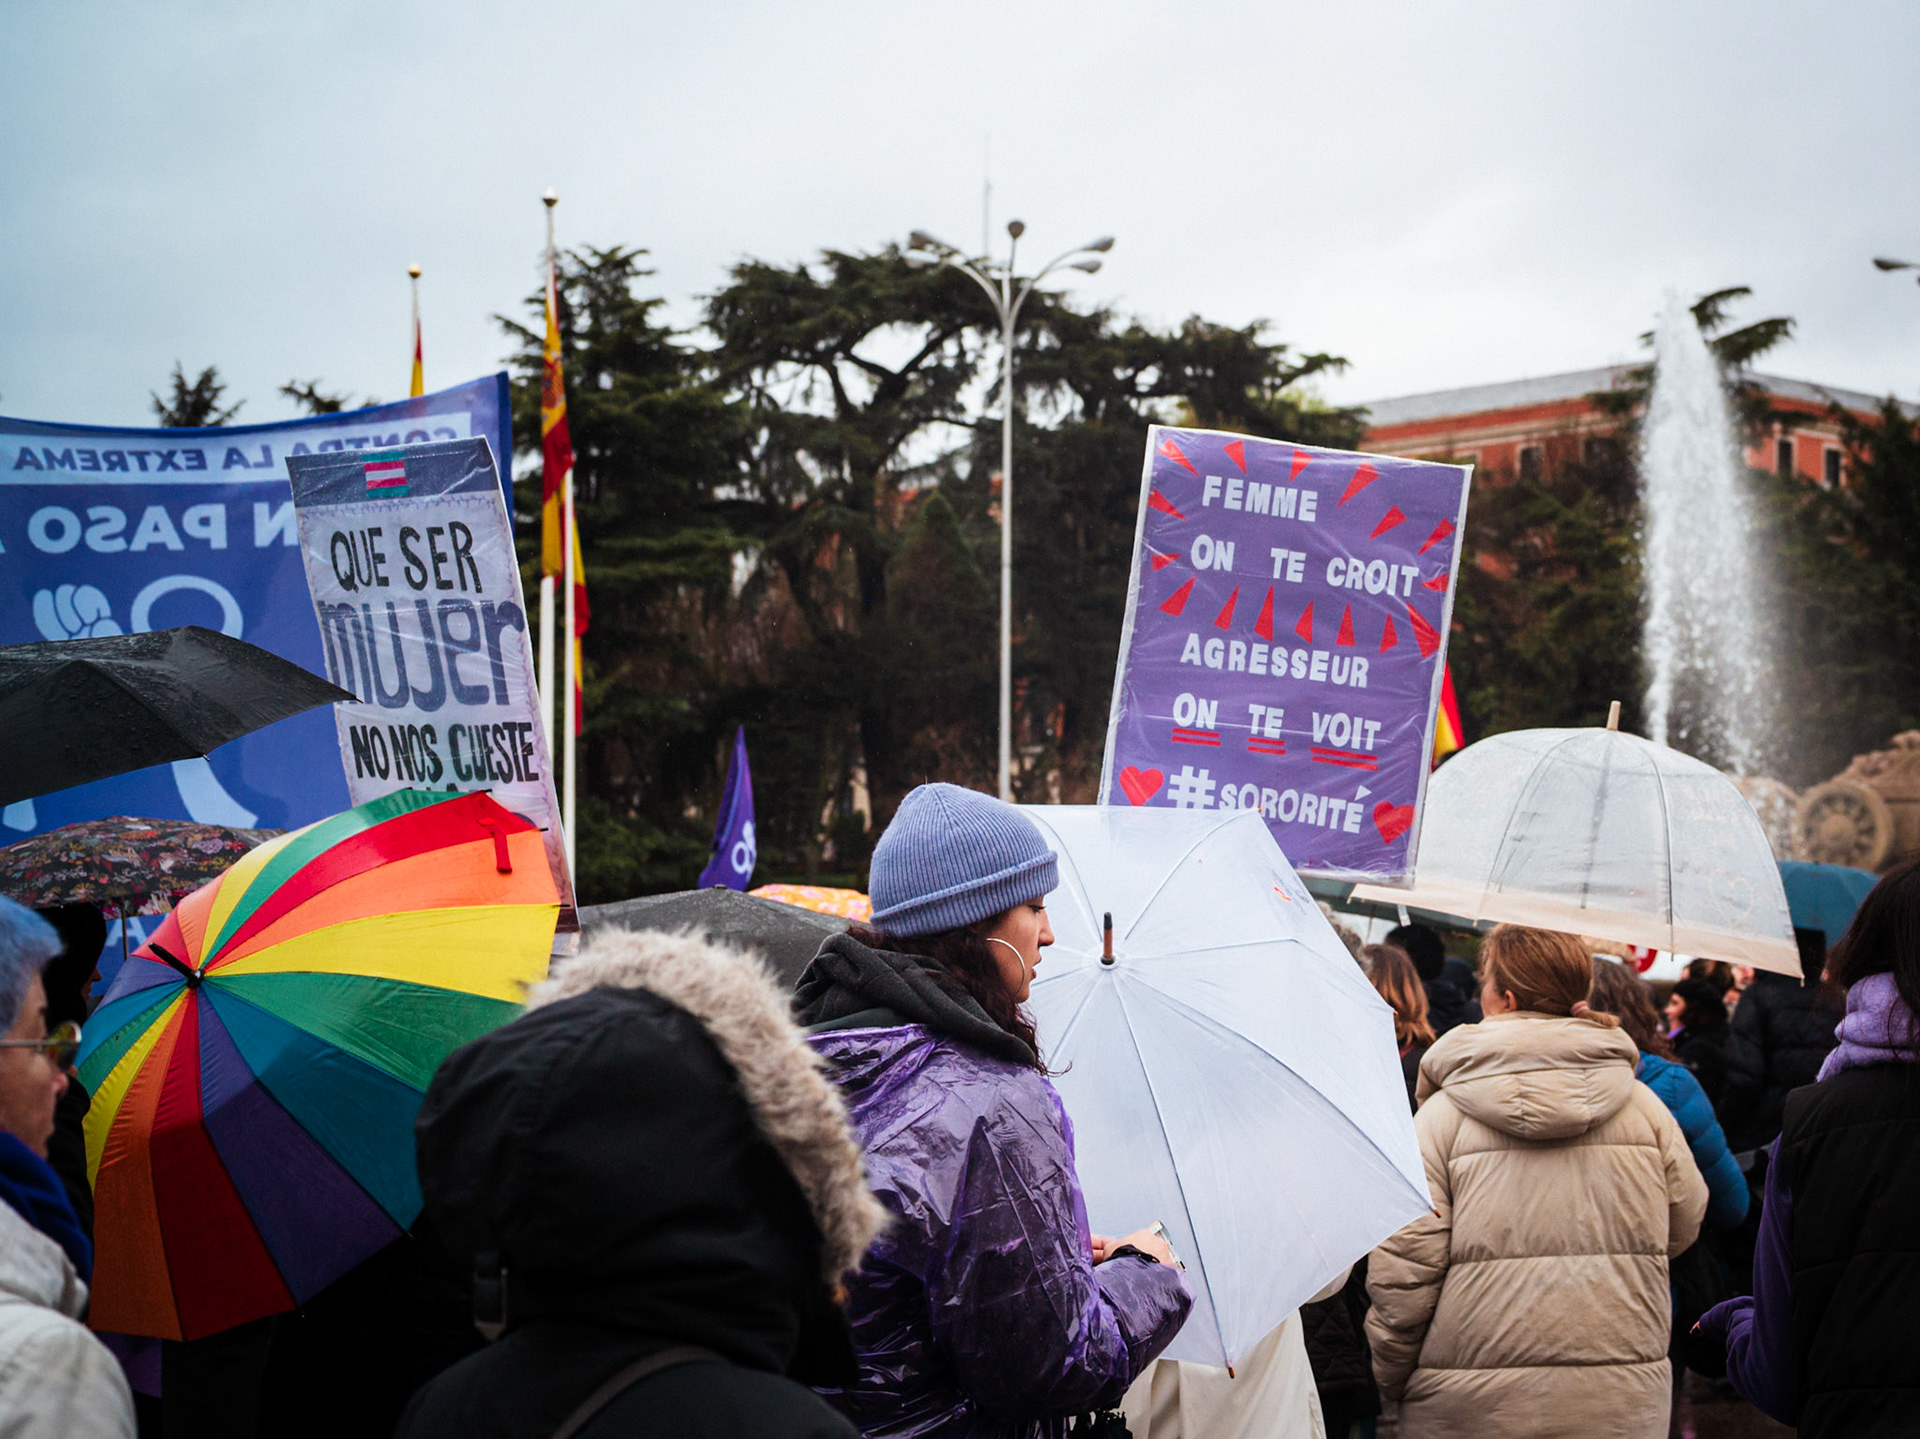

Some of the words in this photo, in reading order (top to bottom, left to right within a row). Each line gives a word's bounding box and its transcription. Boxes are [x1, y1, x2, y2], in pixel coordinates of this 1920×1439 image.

[1202, 475, 1319, 522] FEMME
[330, 527, 390, 593] QUE
[399, 520, 483, 593] SER
[1190, 534, 1235, 572] ON
[1270, 547, 1307, 583] TE
[1326, 556, 1420, 597] CROIT
[1179, 633, 1370, 688] AGRESSEUR
[1172, 692, 1219, 730] ON
[1248, 703, 1285, 739] TE
[1312, 712, 1382, 751] VOIT
[350, 725, 391, 781] NO
[391, 723, 443, 783] NOS
[448, 721, 540, 785] CUESTE
